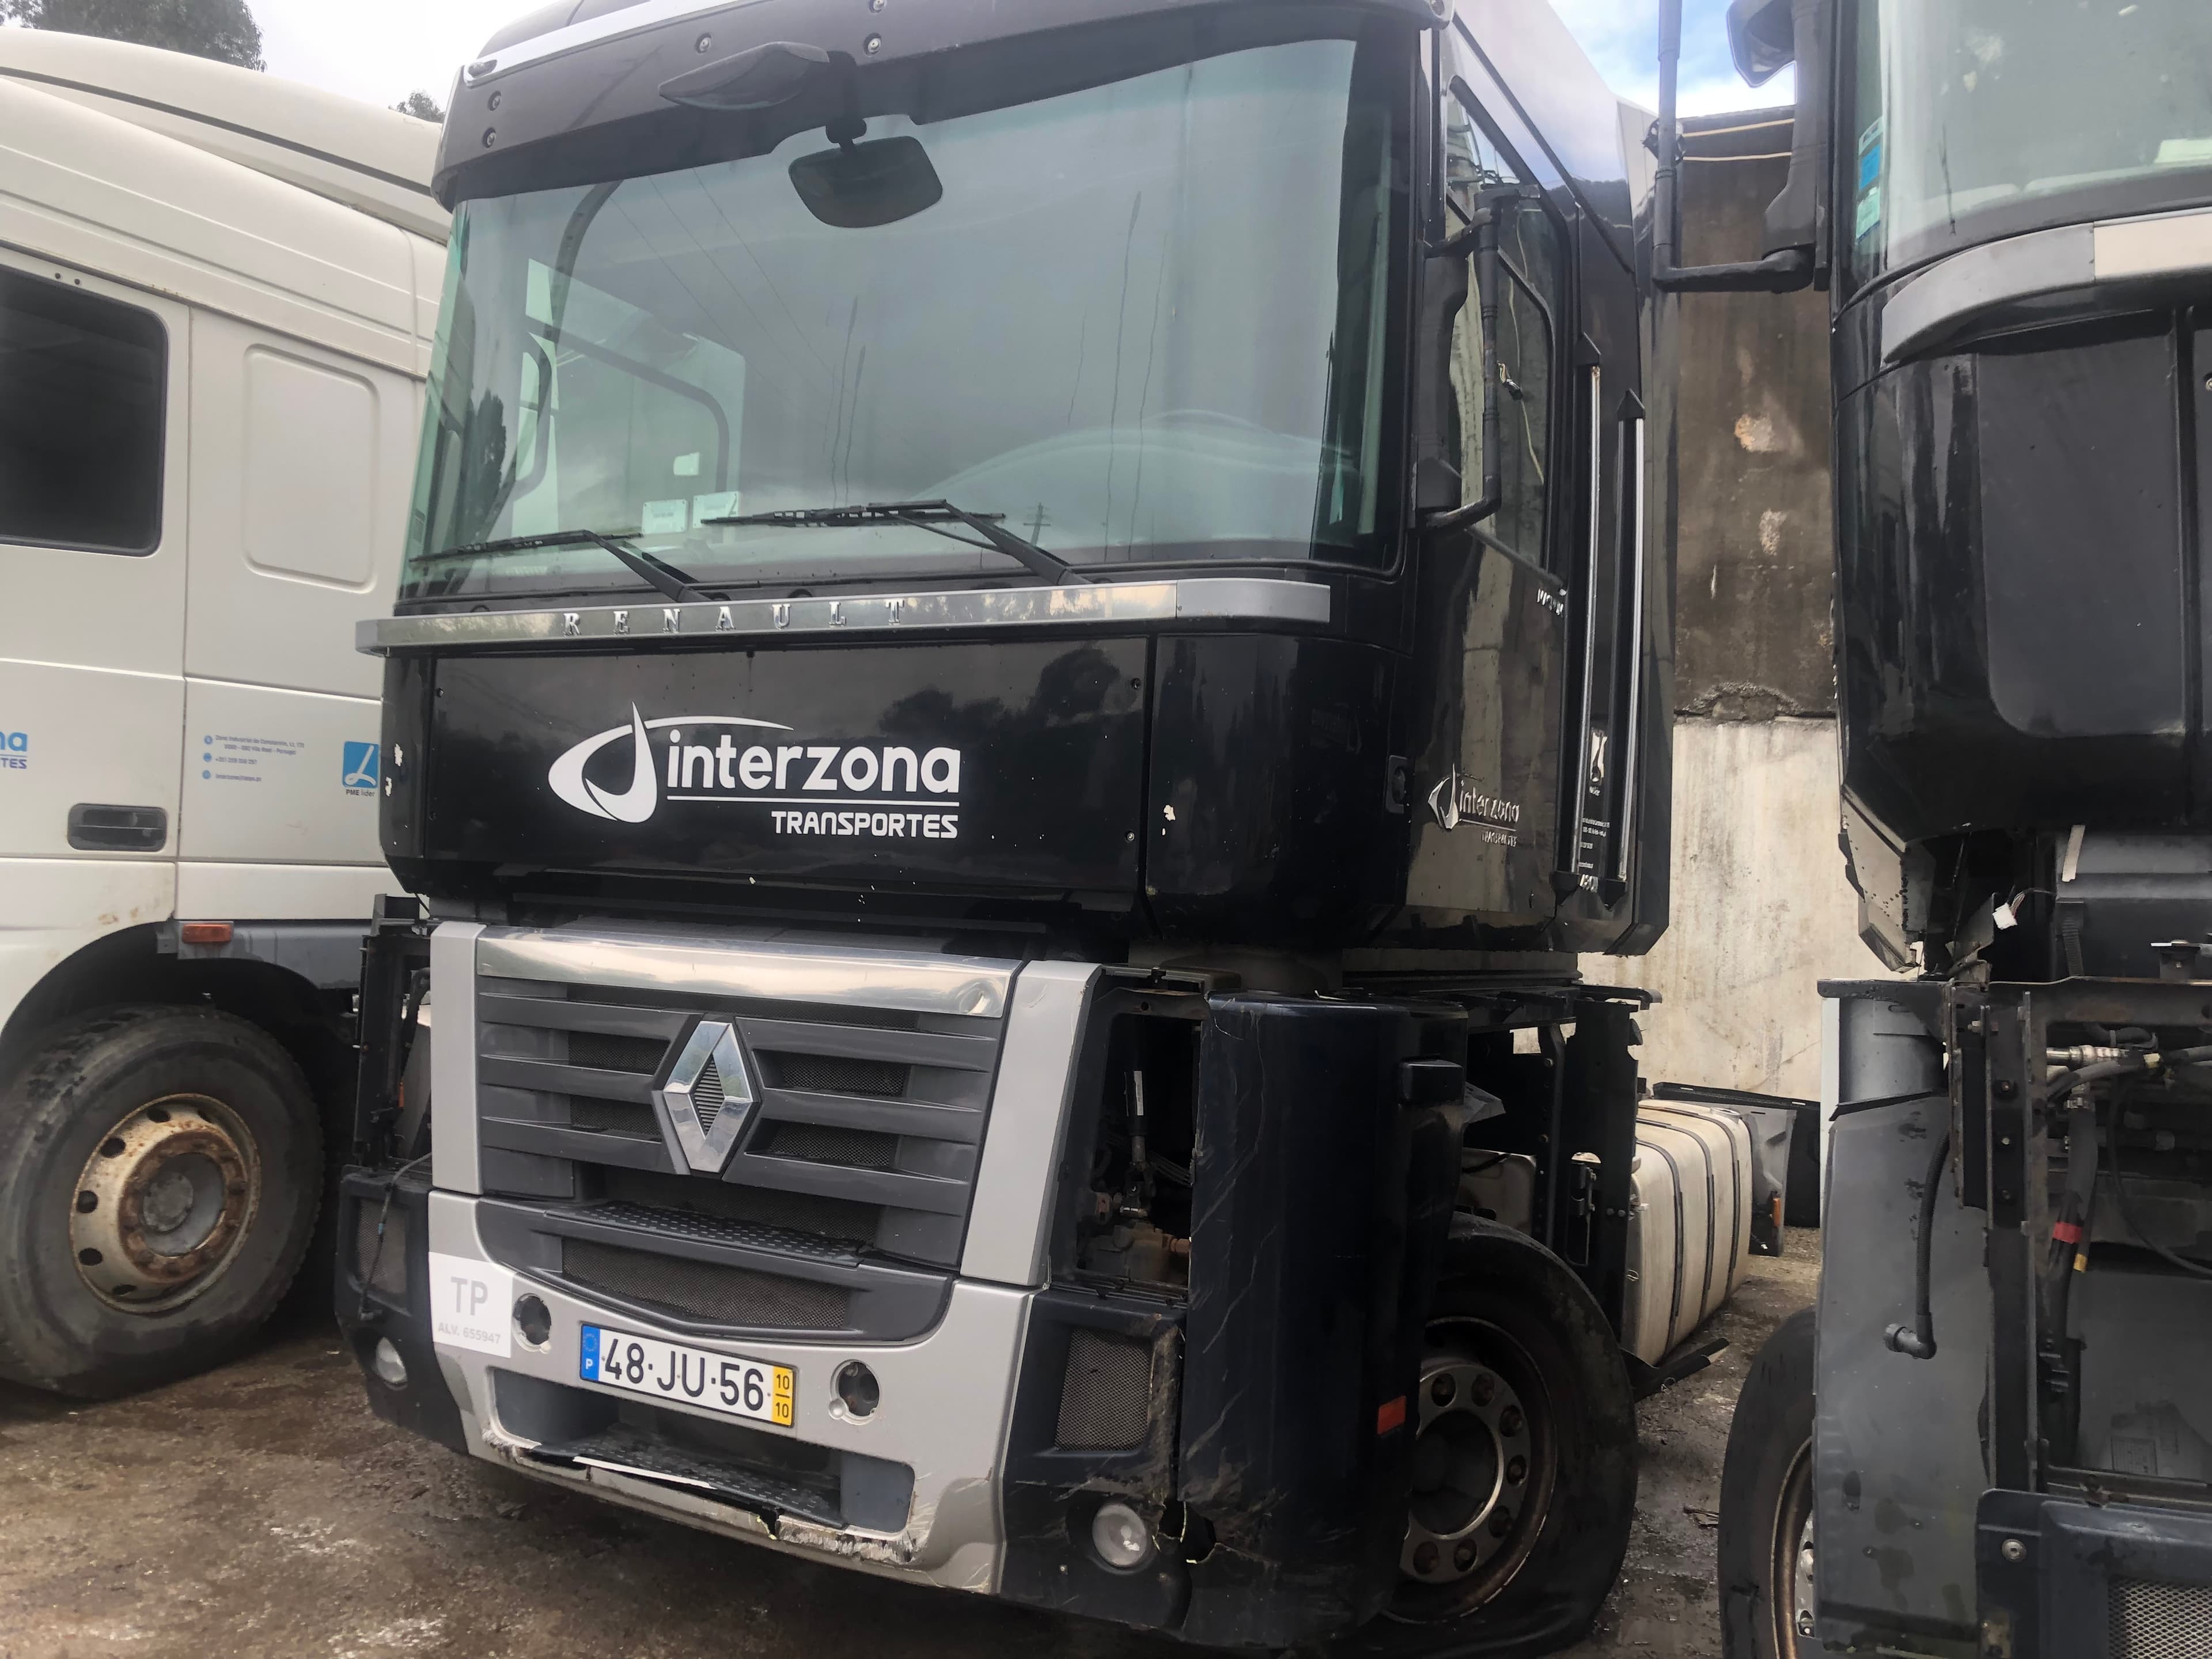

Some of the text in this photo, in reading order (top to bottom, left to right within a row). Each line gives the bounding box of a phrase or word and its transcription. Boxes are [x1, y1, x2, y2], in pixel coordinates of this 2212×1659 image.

[563, 599, 905, 635] RENAULT
[667, 729, 961, 794] interzona
[1459, 779, 1520, 823] interzona
[771, 811, 958, 839] TRANSPORTES
[451, 1276, 488, 1316] TP
[438, 1323, 501, 1344] ALV. 655947
[585, 1358, 593, 1369] P
[776, 1373, 790, 1391] 10
[775, 1402, 789, 1418] 10
